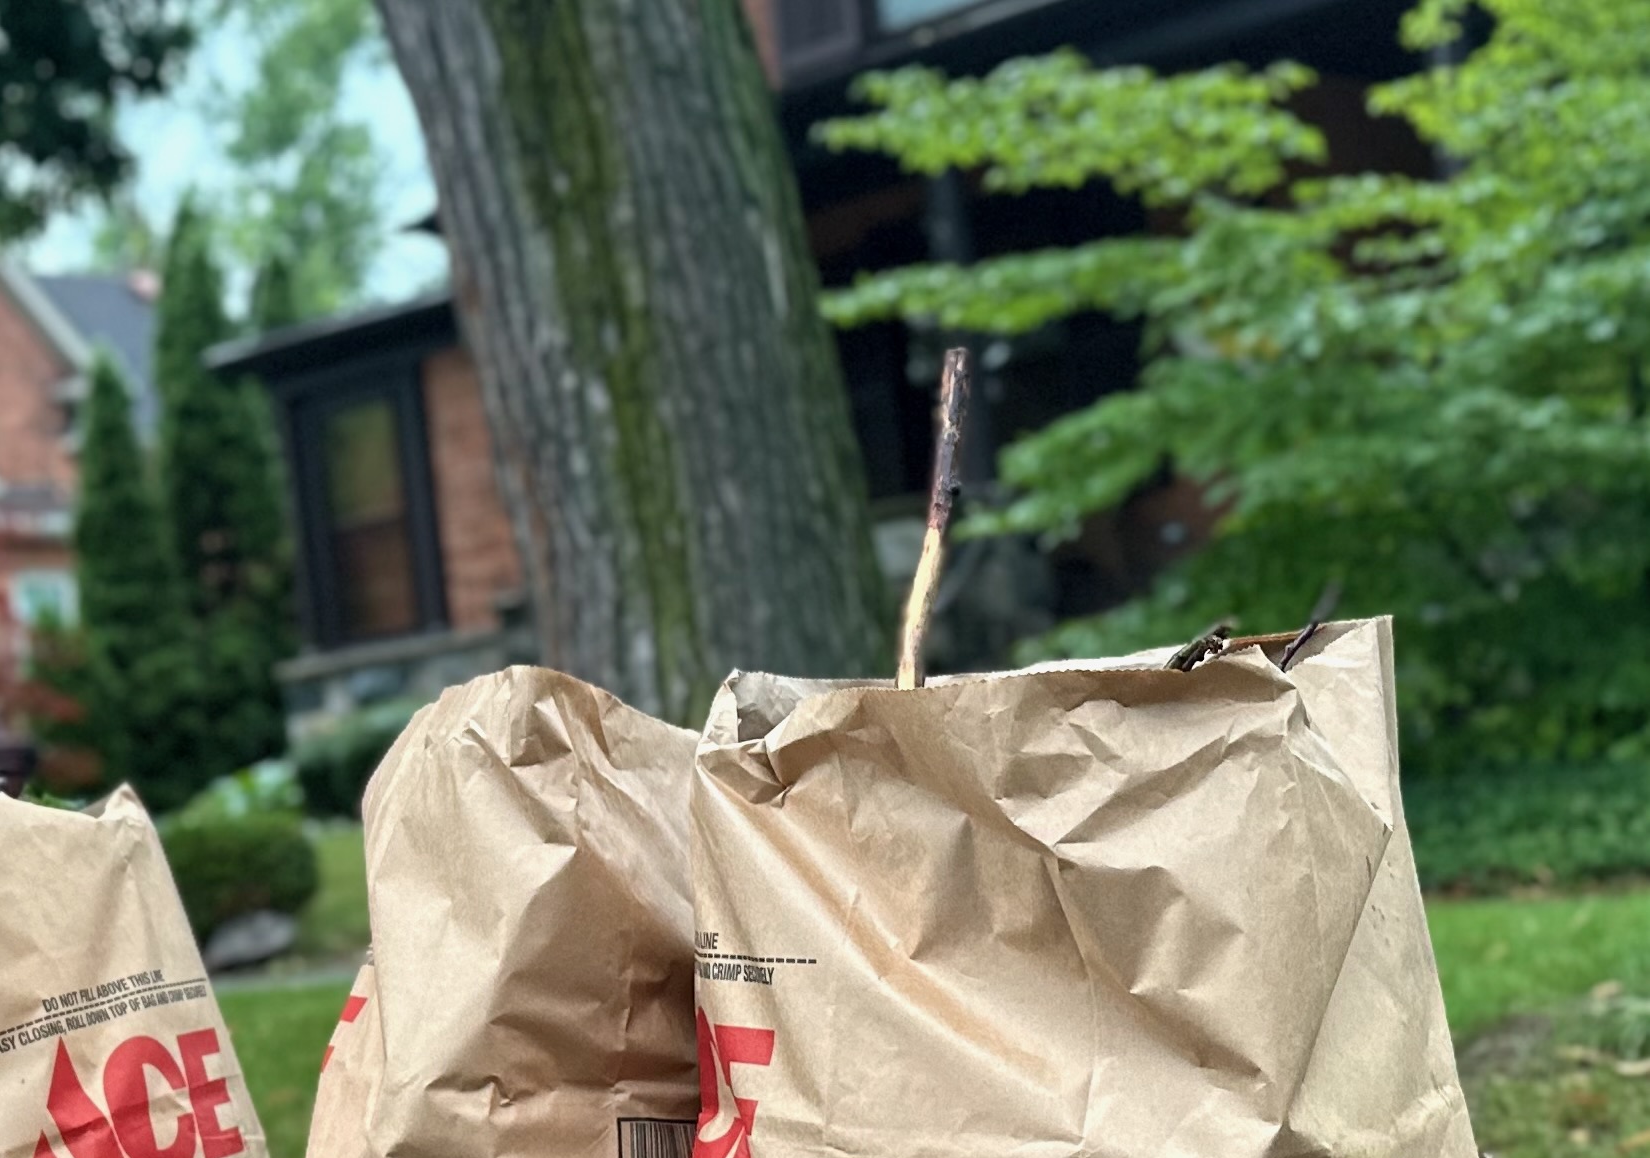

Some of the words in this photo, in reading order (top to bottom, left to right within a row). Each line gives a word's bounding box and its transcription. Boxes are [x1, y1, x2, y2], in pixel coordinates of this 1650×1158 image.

[41, 996, 59, 1013] DO
[59, 991, 79, 1009] NOT
[79, 988, 97, 1003] FILL
[96, 978, 130, 999] ABOVE
[127, 971, 152, 988] THIS
[712, 962, 742, 982] CRIMP
[18, 1019, 68, 1046] CLOSING,
[66, 1014, 87, 1032] ROLL
[85, 1007, 111, 1026] DOWN
[108, 1001, 128, 1018] TOP
[128, 997, 141, 1012] OF
